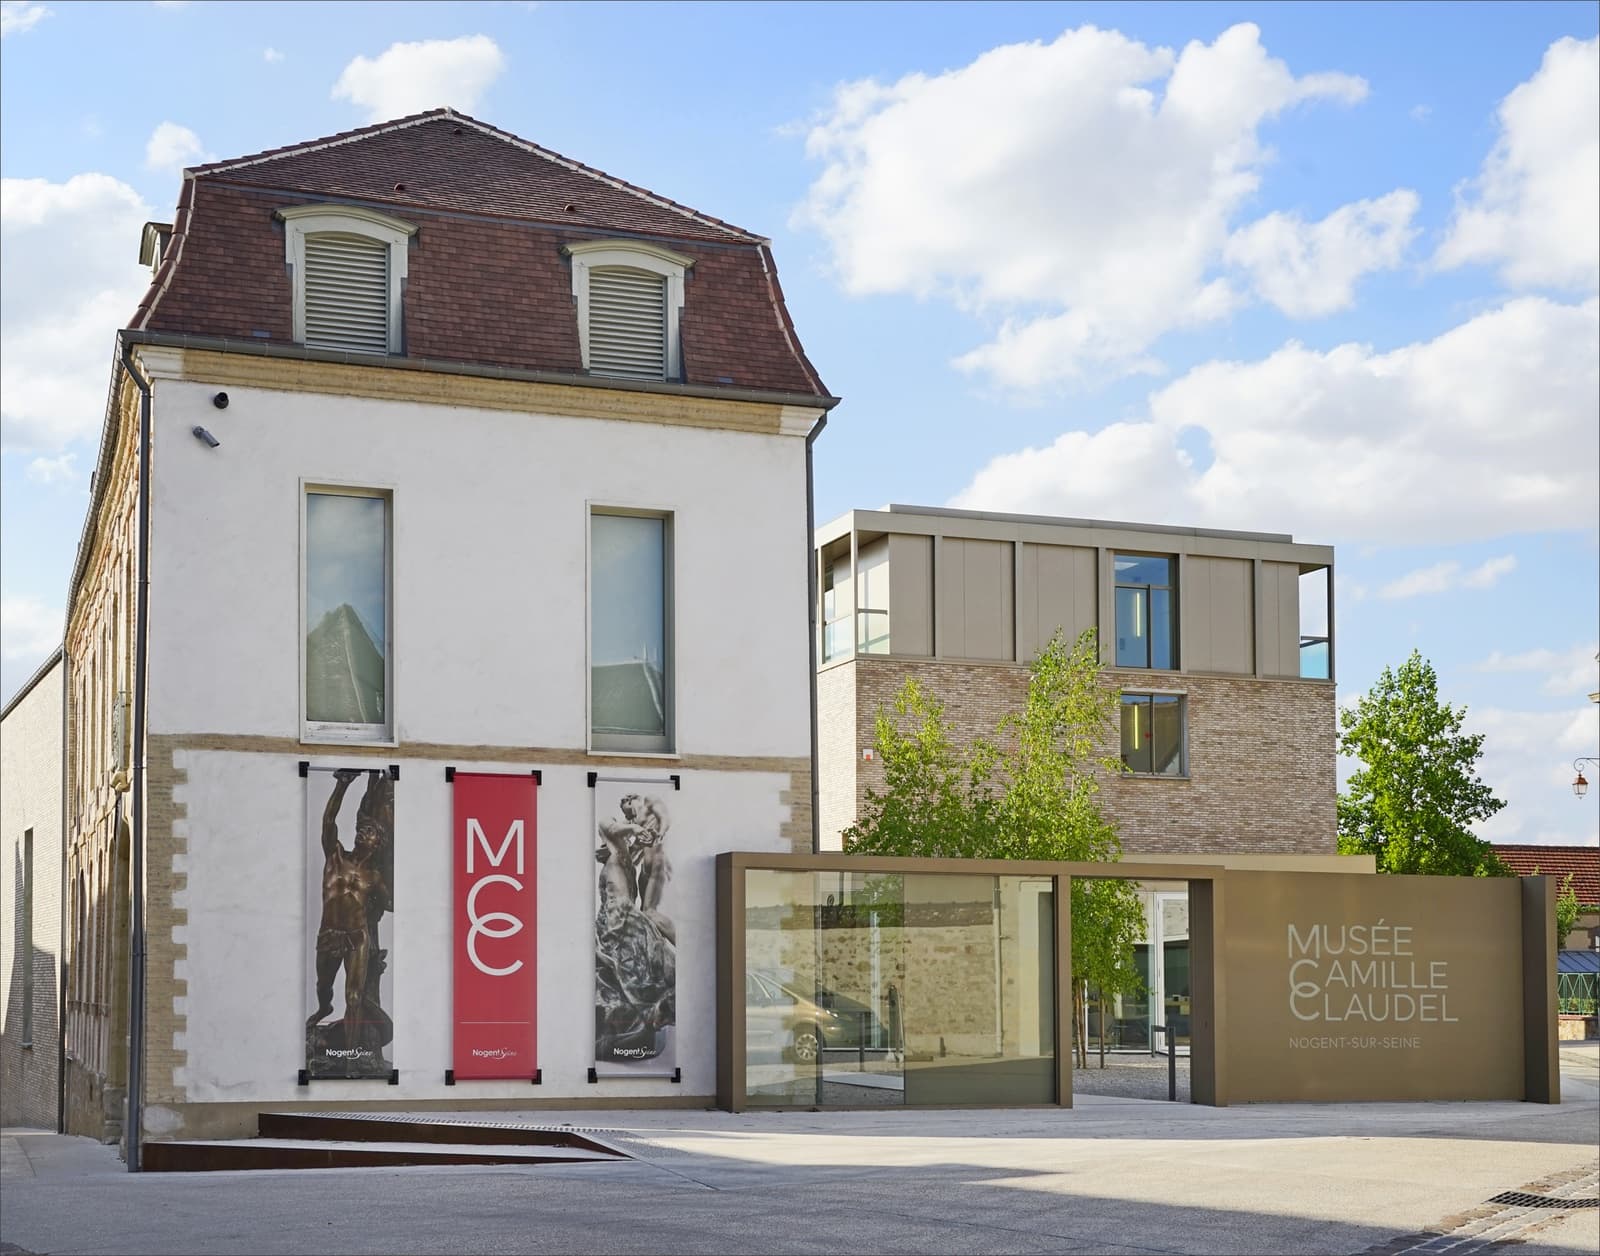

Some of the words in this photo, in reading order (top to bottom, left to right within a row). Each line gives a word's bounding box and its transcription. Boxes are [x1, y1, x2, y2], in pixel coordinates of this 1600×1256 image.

[1287, 918, 1414, 959] MUSÉE
[1288, 959, 1449, 998] CAMILLE
[1289, 982, 1459, 1022] CLAUDEL
[325, 1048, 354, 1058] Nogent
[613, 1047, 640, 1057] Nogent
[1289, 1037, 1422, 1049] NOGENT-SUR-SEINE
